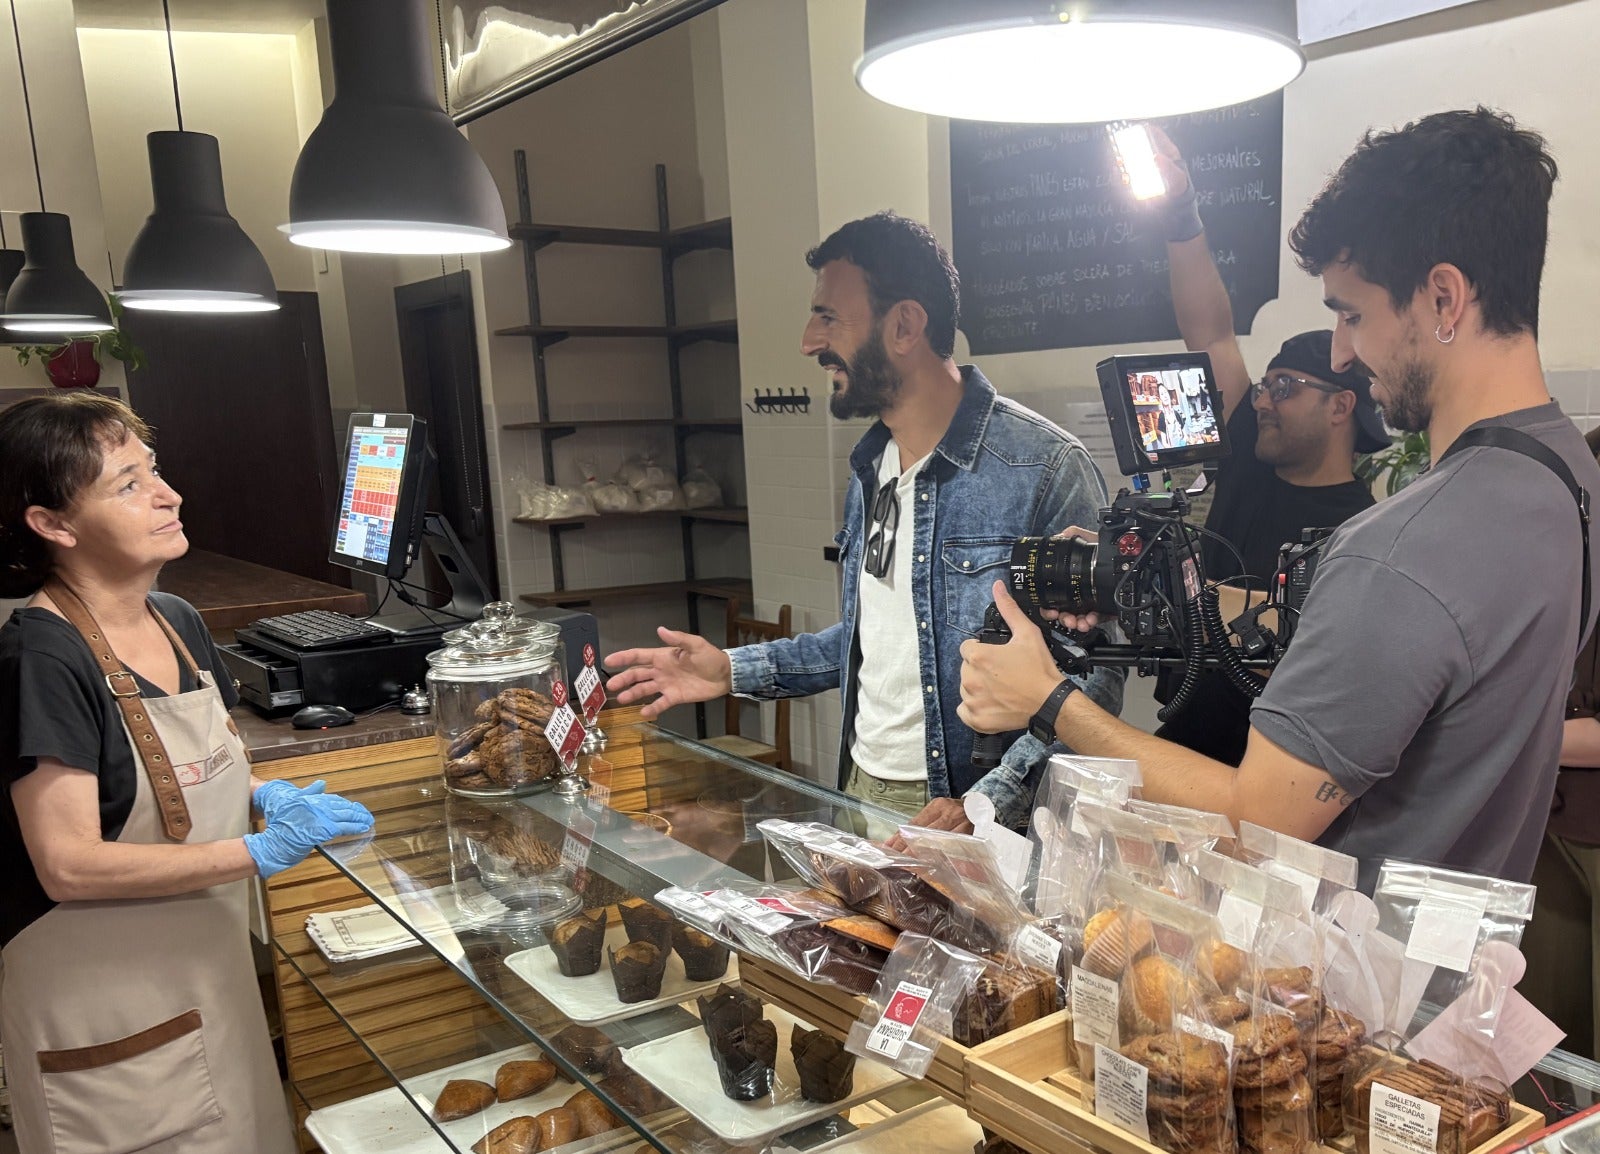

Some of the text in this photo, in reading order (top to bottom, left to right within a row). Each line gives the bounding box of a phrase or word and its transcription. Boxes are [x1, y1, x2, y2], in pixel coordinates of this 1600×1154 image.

[1116, 263, 1135, 279] DE
[1013, 572, 1025, 584] 21
[576, 667, 594, 692] GALLETAS
[549, 705, 568, 741] GALLETAS
[554, 711, 573, 749] CHOCO
[879, 1037, 890, 1052] LA
[1384, 1099, 1426, 1121] ESPECIADAS
[1387, 1092, 1421, 1111] GALLETAS
